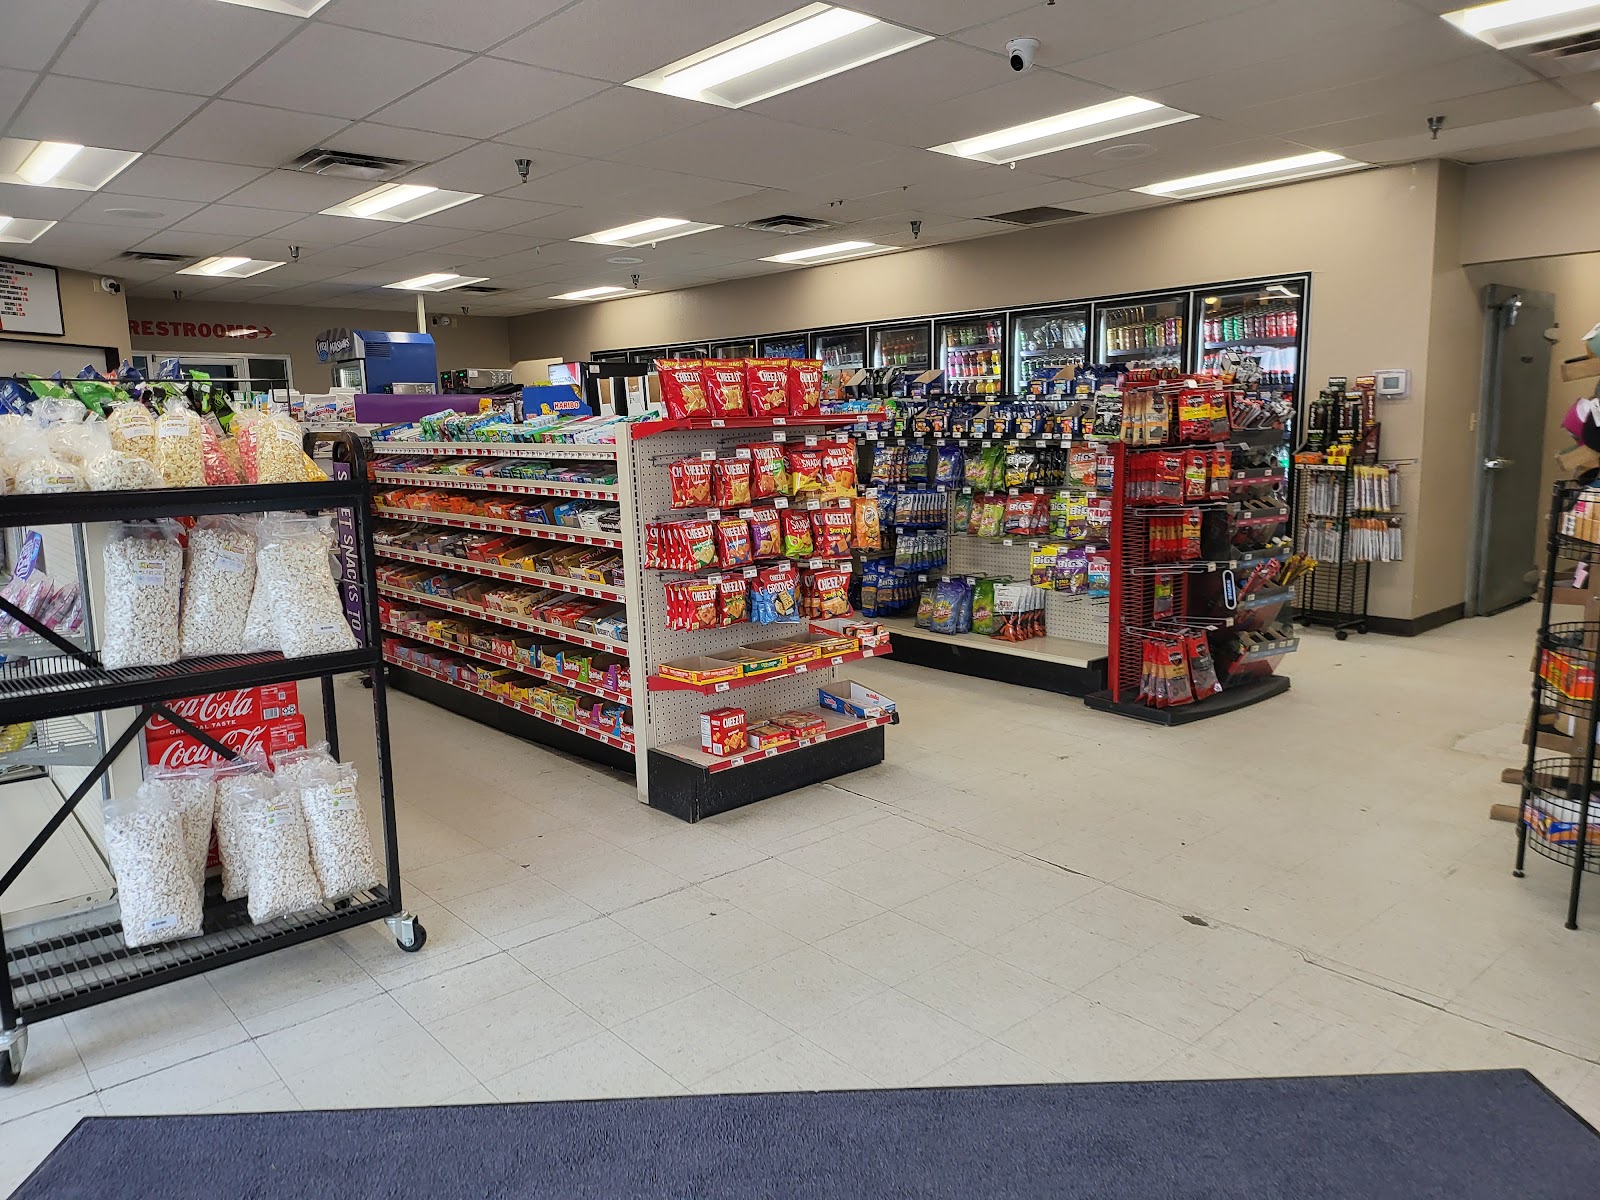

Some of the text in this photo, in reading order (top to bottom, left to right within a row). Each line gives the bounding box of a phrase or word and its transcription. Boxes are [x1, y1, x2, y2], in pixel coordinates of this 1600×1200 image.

[128, 319, 259, 339] RESTROOMS
[553, 401, 580, 410] HARIBO
[341, 533, 359, 603] SNACKS
[767, 580, 795, 594] GROOVES
[211, 719, 237, 728] TASTE
